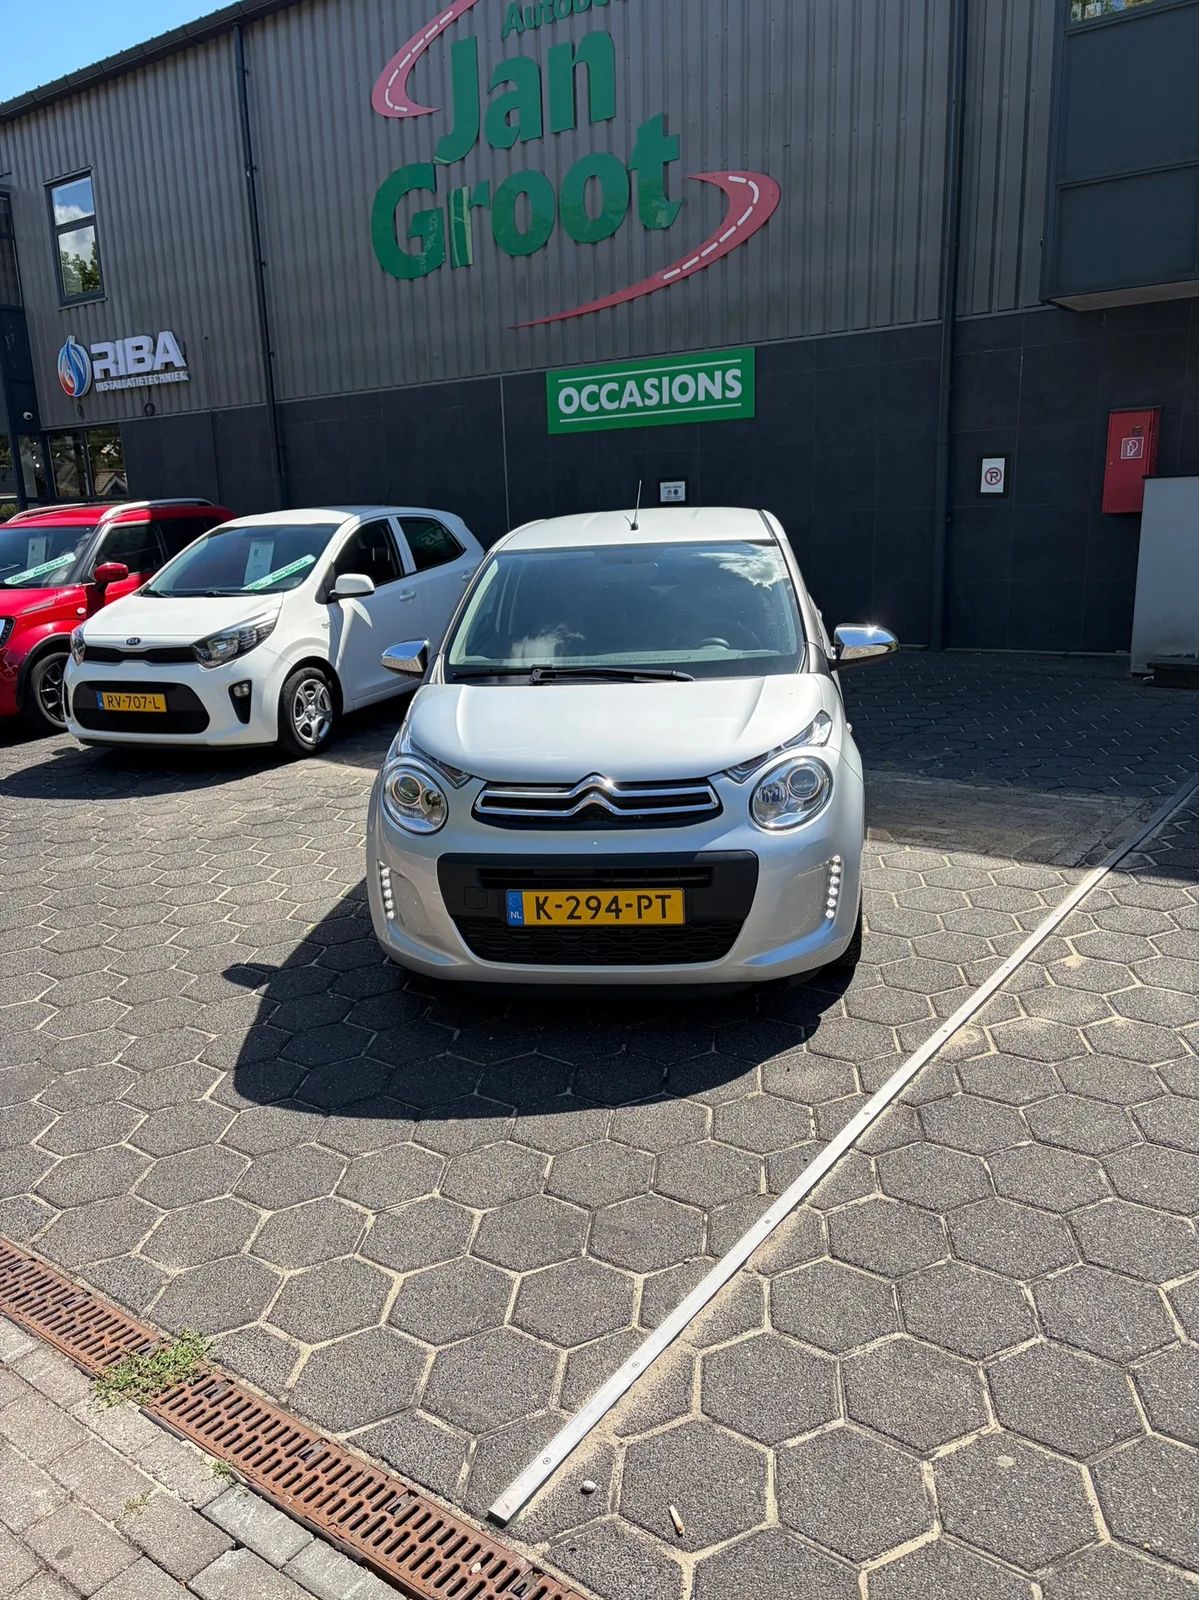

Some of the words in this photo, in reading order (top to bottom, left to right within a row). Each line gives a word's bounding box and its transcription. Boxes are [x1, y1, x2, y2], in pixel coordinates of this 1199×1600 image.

[502, 0, 609, 38] Auto
[433, 30, 616, 165] Jan
[371, 112, 685, 279] Groot
[90, 331, 187, 379] RIBA
[95, 370, 189, 392] INSTALLATIETECHNIEK
[558, 368, 742, 415] OCCASIONS
[107, 694, 161, 710] RV-707-L
[510, 911, 522, 919] NL
[535, 894, 672, 920] K-294-PT
